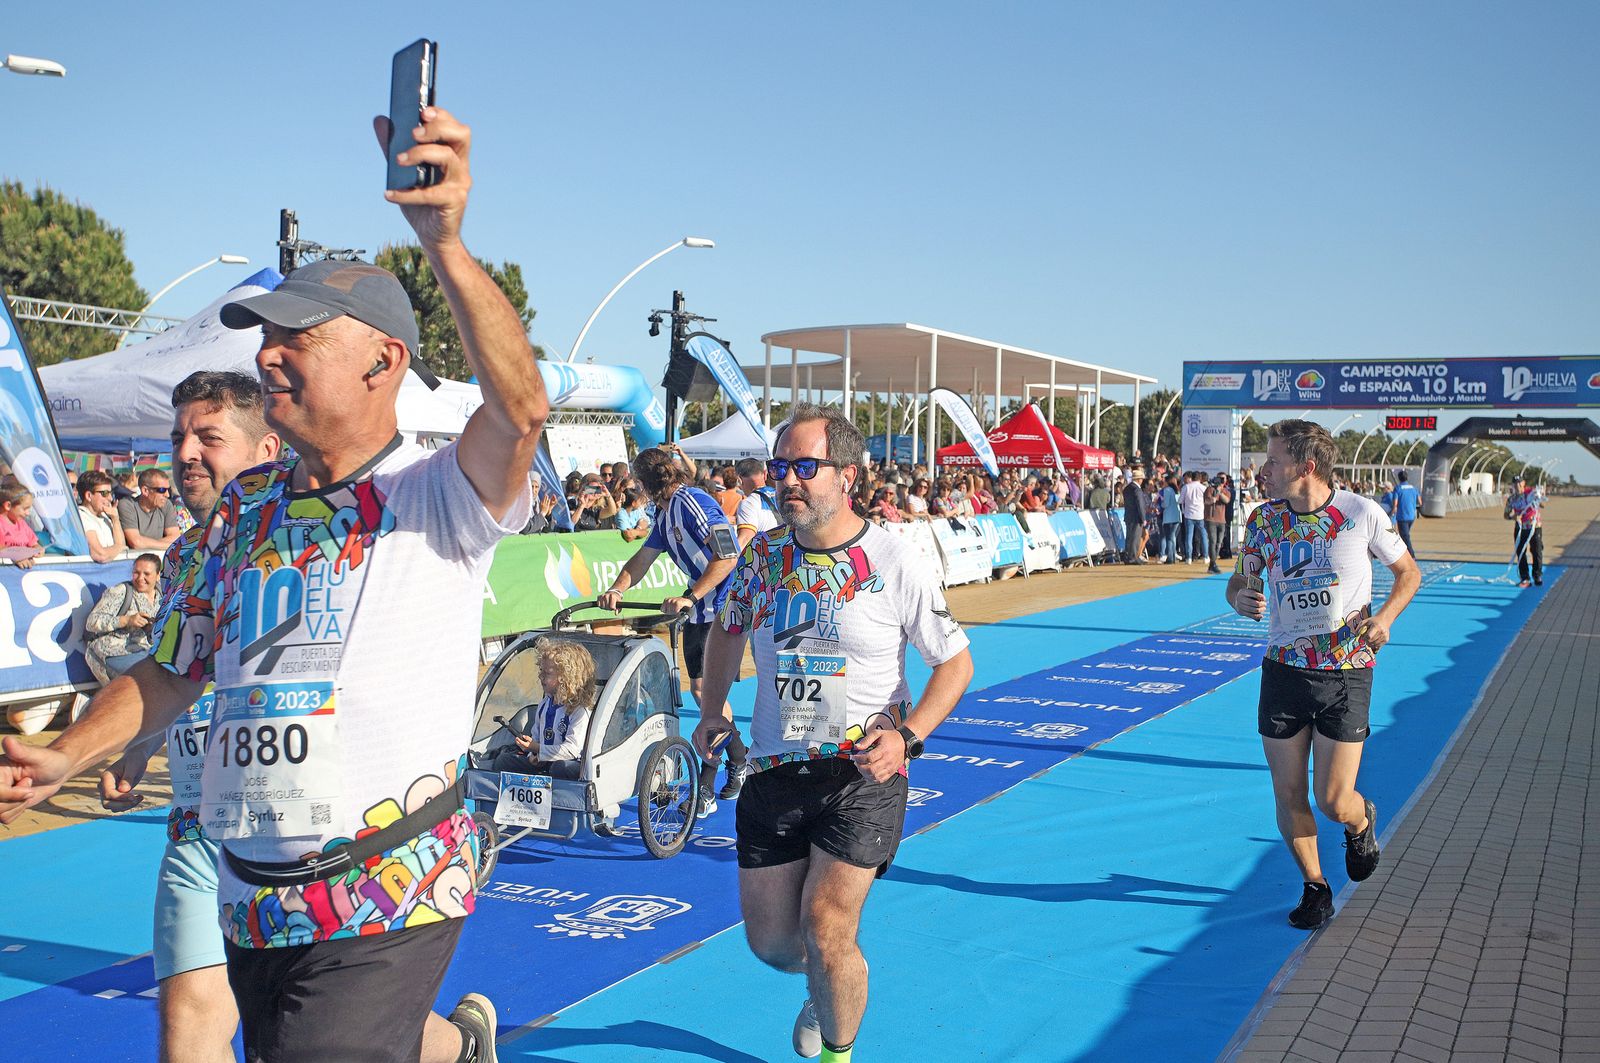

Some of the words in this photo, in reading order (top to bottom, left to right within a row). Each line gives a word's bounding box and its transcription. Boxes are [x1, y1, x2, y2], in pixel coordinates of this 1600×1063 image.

[1340, 365, 1448, 378] CAMPEONATO
[1340, 382, 1356, 393] de
[1360, 379, 1413, 393] ESPAÑA
[1423, 378, 1447, 394] 10
[1454, 376, 1487, 394] km
[1531, 373, 1577, 386] HUELVA
[1298, 391, 1321, 399] WiHu
[1410, 394, 1446, 402] Absoluto
[1449, 396, 1454, 404] y
[1457, 394, 1487, 402] Master
[306, 562, 345, 588] HU
[1315, 577, 1333, 587] 2023
[306, 587, 344, 613] EL
[1287, 590, 1331, 610] 1590
[305, 614, 342, 640] VA
[800, 646, 839, 655] DESCUBRIMIENTO
[814, 640, 829, 648] PUERTA
[301, 648, 327, 659] PUERTA
[281, 660, 341, 673] DESCUBRIMIENTO
[813, 661, 838, 672] 2023
[1096, 662, 1223, 676] Huelva
[275, 691, 322, 710] 2023
[994, 698, 1143, 713] Huelva
[791, 724, 815, 733] Syrluz
[219, 724, 308, 768] 1880
[510, 787, 543, 805] 1608
[248, 809, 285, 823] Syrluz
